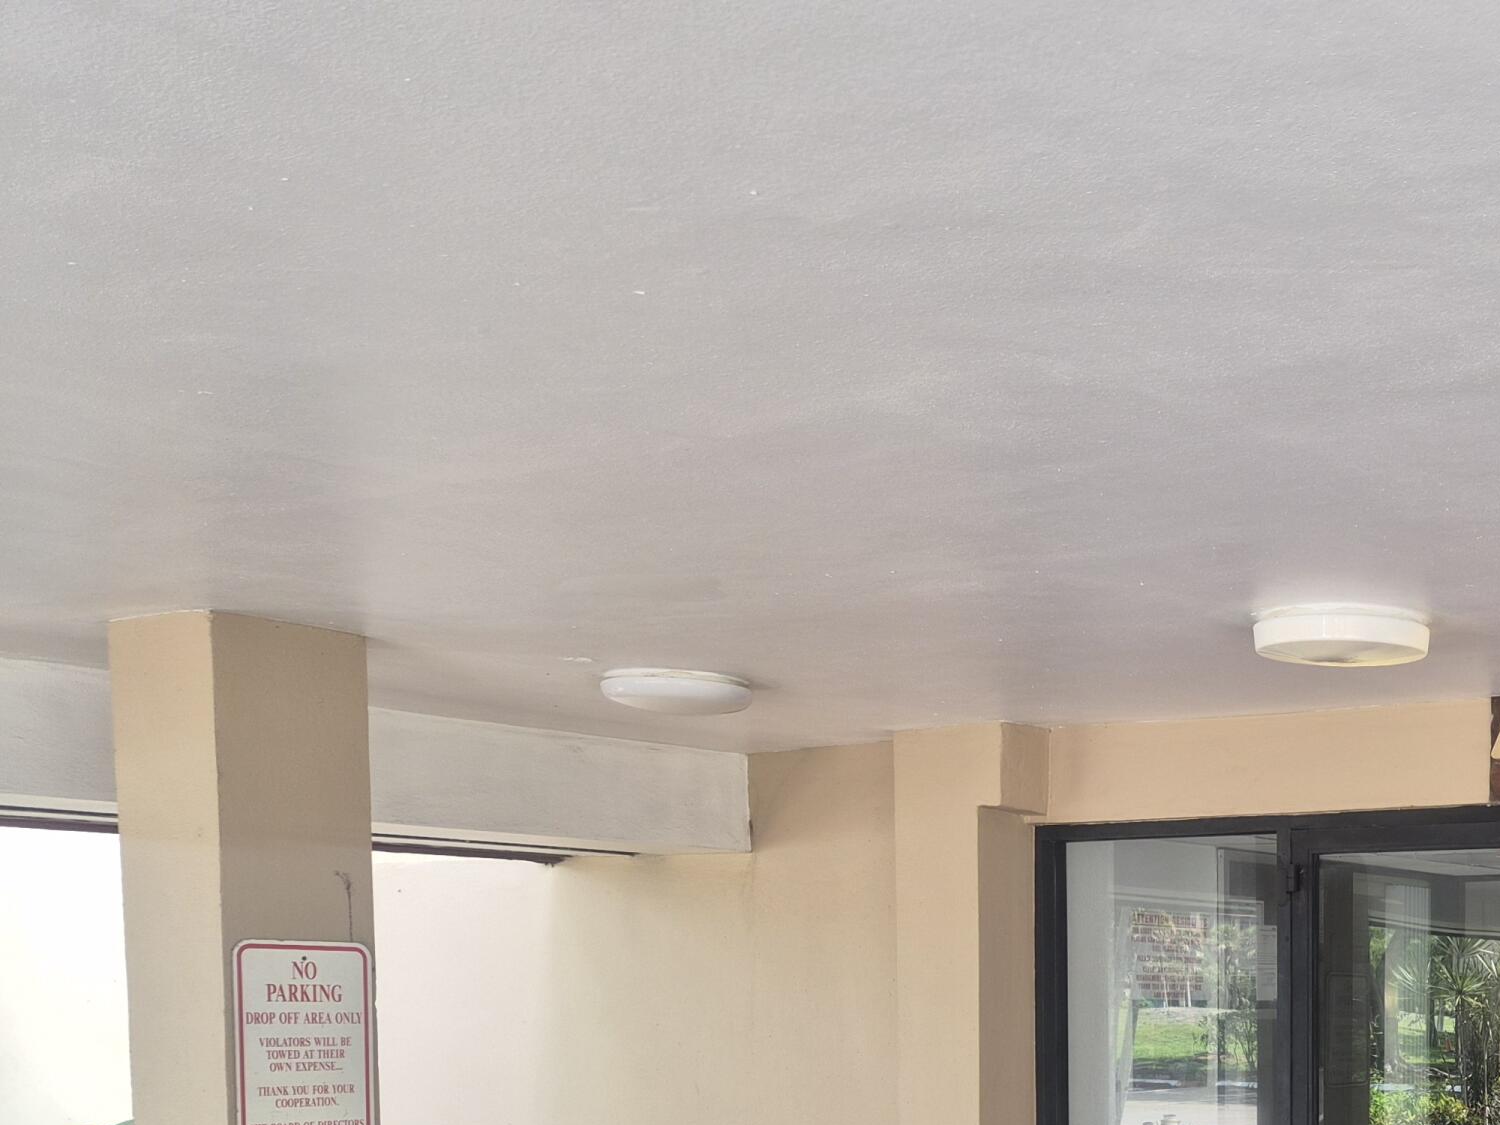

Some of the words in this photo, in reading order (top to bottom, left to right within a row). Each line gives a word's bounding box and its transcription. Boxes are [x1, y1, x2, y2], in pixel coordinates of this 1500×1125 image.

[292, 961, 317, 980] NO
[266, 983, 342, 1003] PARKING
[246, 1012, 275, 1025] DROP
[279, 1012, 300, 1025] OFF
[304, 1012, 332, 1025] AREA
[335, 1012, 362, 1025] ONLY
[259, 1037, 311, 1048] VIOLATORS
[315, 1037, 338, 1047] WILL
[341, 1036, 352, 1047] BE
[266, 1050, 302, 1060] TOWED
[304, 1050, 317, 1060] AT
[318, 1049, 345, 1059] THEIR
[269, 1062, 292, 1072] OWN
[258, 1086, 289, 1096] THANK
[291, 1085, 310, 1096] YOU
[312, 1085, 329, 1095] FOR
[332, 1084, 355, 1095] YOUR
